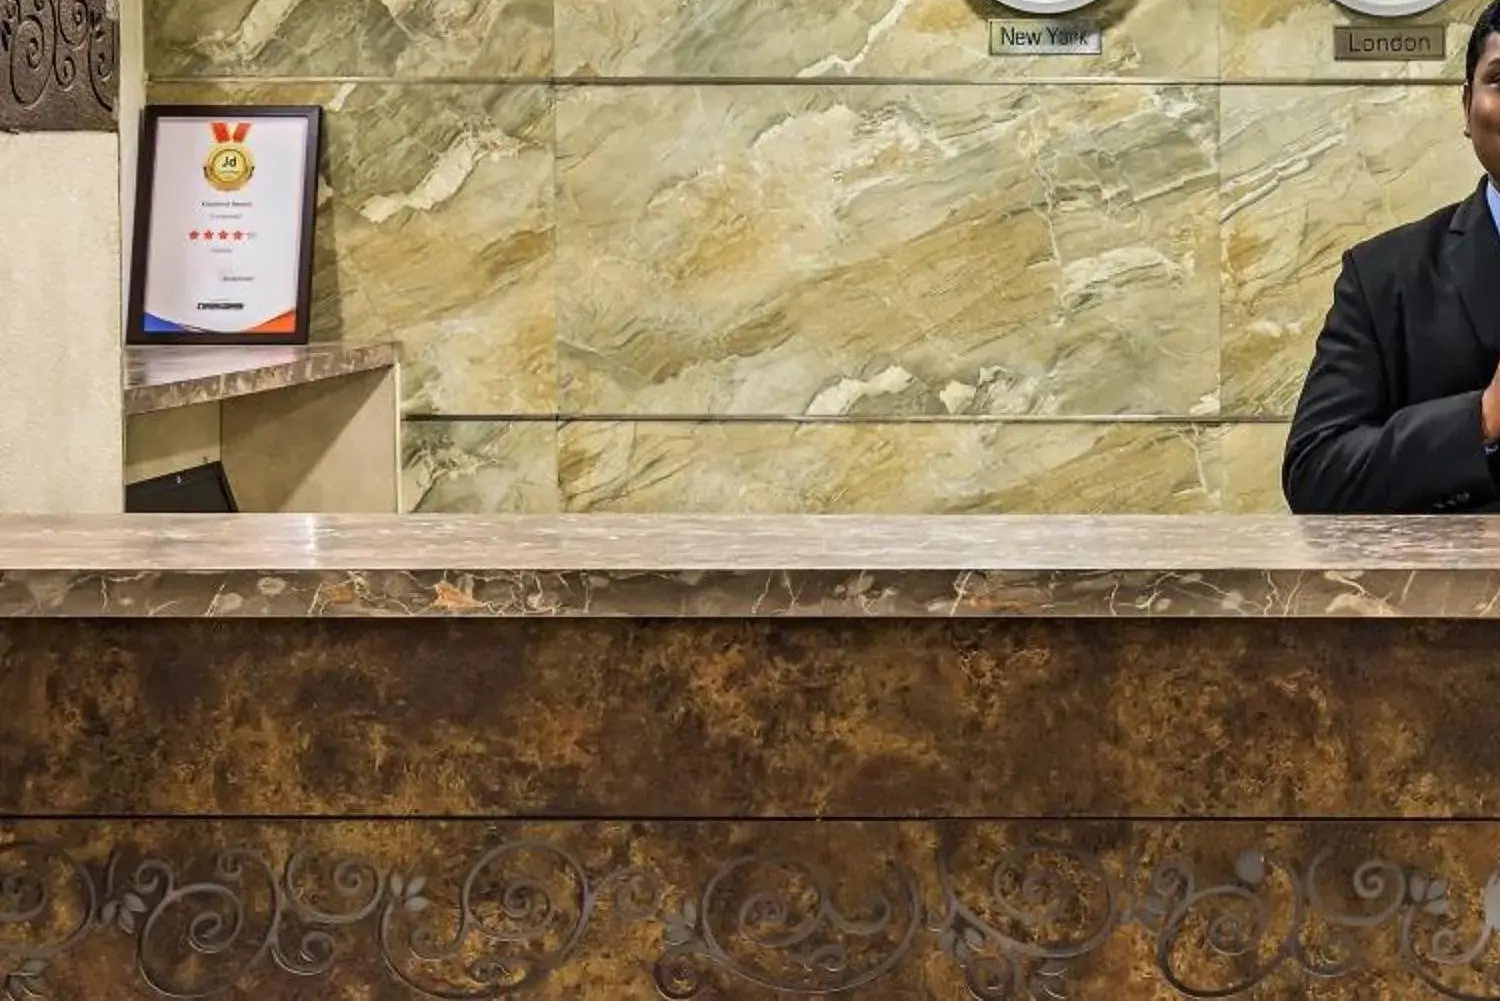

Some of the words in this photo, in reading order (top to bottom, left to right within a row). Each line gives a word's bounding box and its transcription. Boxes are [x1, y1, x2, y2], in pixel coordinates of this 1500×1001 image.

[1000, 26, 1041, 46] New
[1046, 26, 1088, 46] York
[1349, 31, 1431, 52] London
